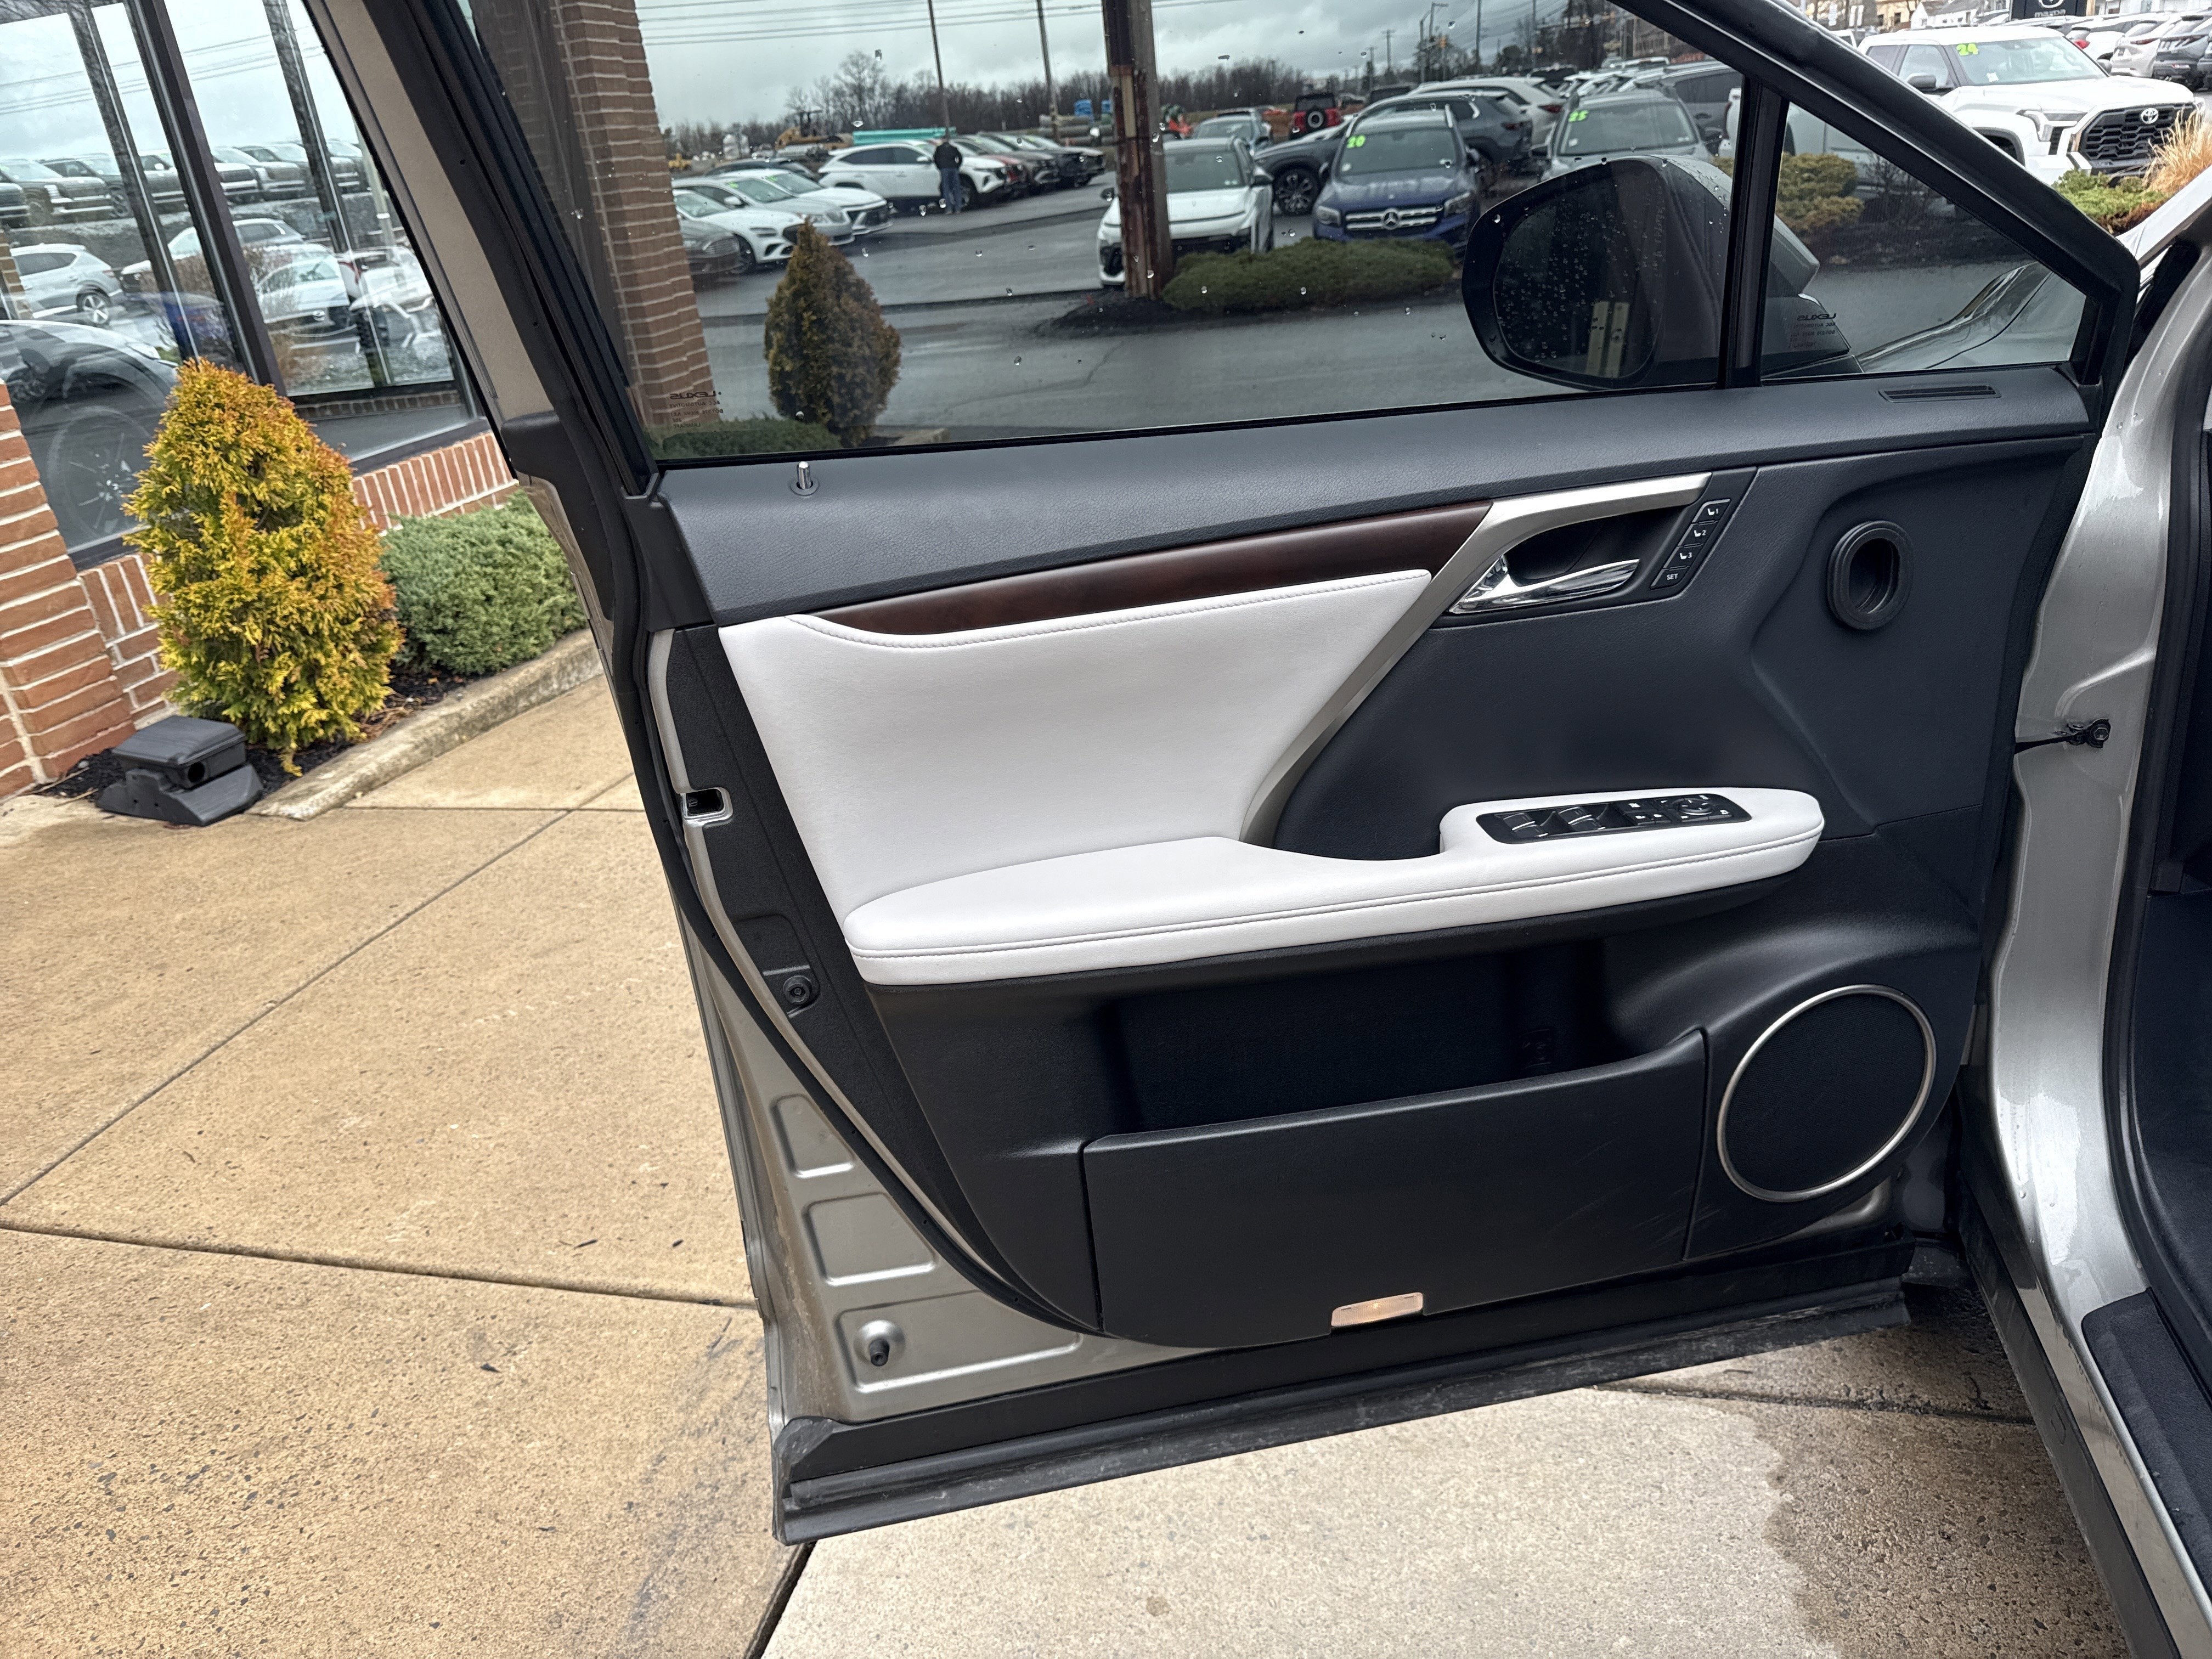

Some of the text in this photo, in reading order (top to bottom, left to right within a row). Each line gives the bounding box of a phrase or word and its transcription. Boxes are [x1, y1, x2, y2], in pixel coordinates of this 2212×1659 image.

[1956, 43, 1978, 56] 24
[1568, 110, 1589, 122] 25
[1346, 135, 1365, 149] 20
